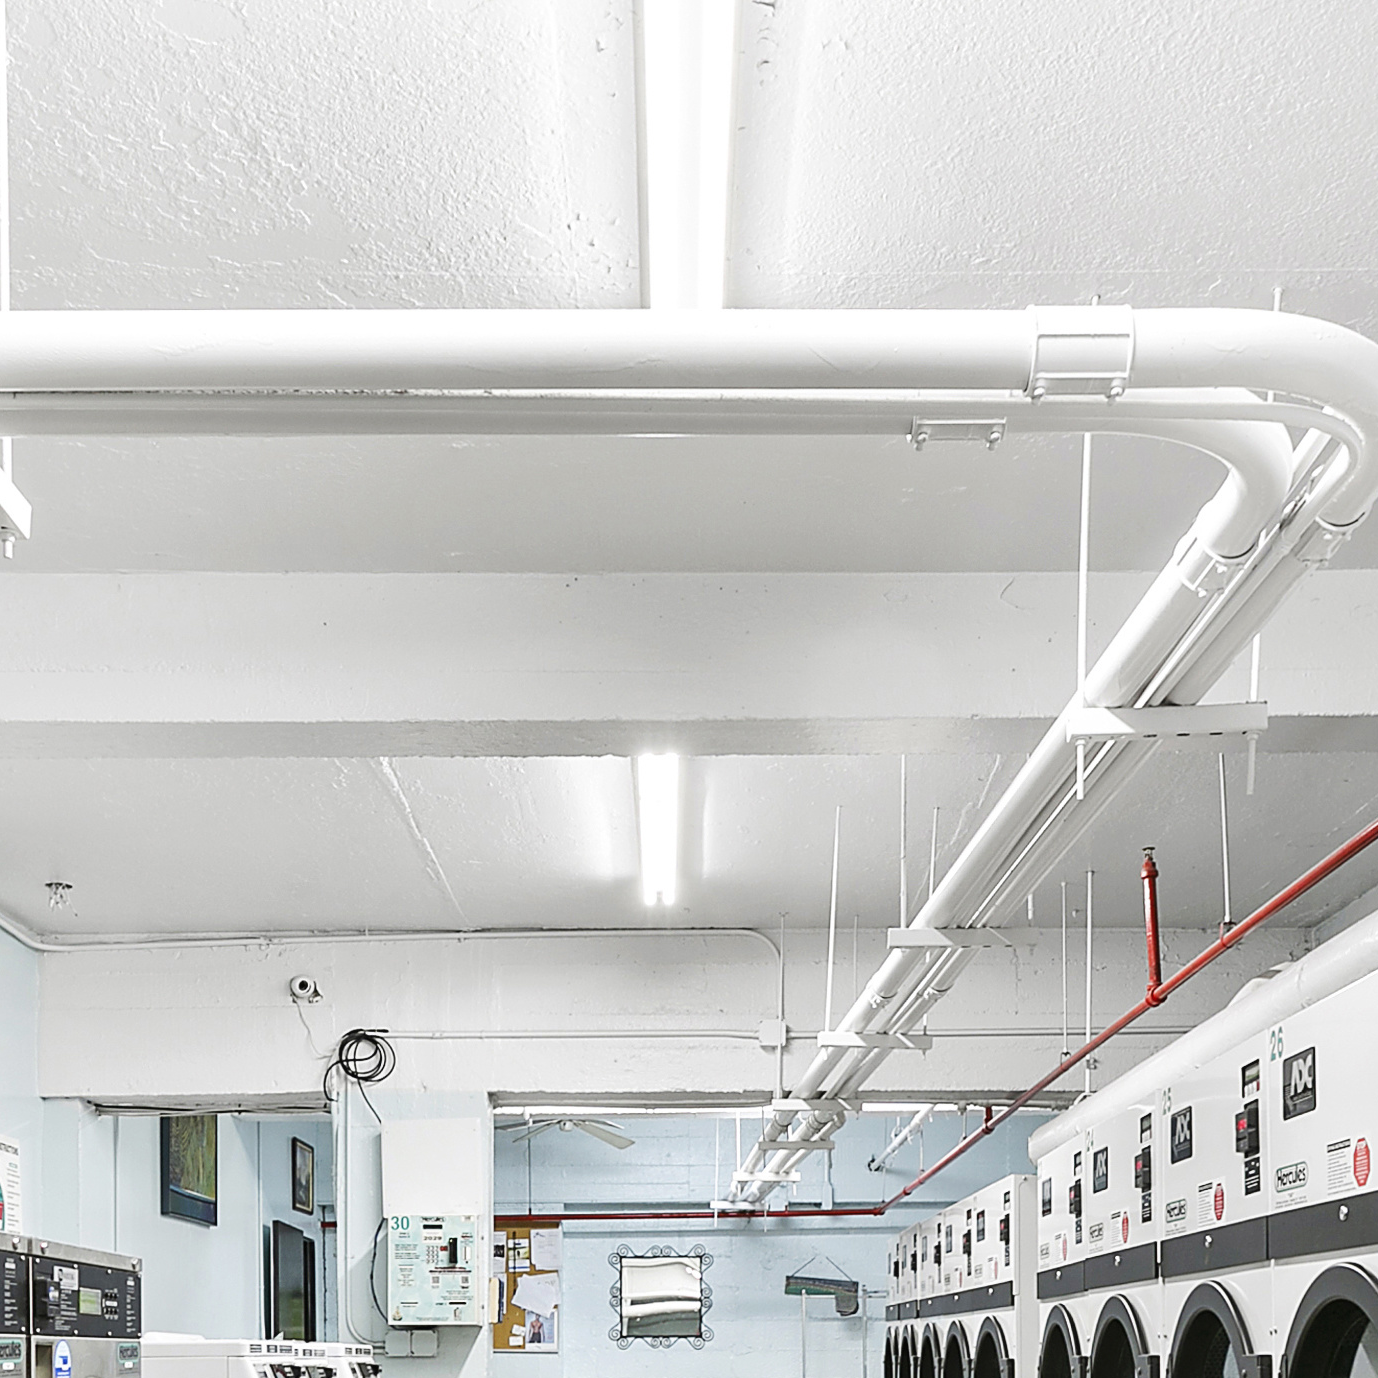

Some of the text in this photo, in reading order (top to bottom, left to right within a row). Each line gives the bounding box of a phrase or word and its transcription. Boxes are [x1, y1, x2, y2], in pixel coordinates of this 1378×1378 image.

[1270, 1026, 1284, 1062] 26
[1276, 1164, 1307, 1189] Hercules
[391, 1216, 410, 1230] 30
